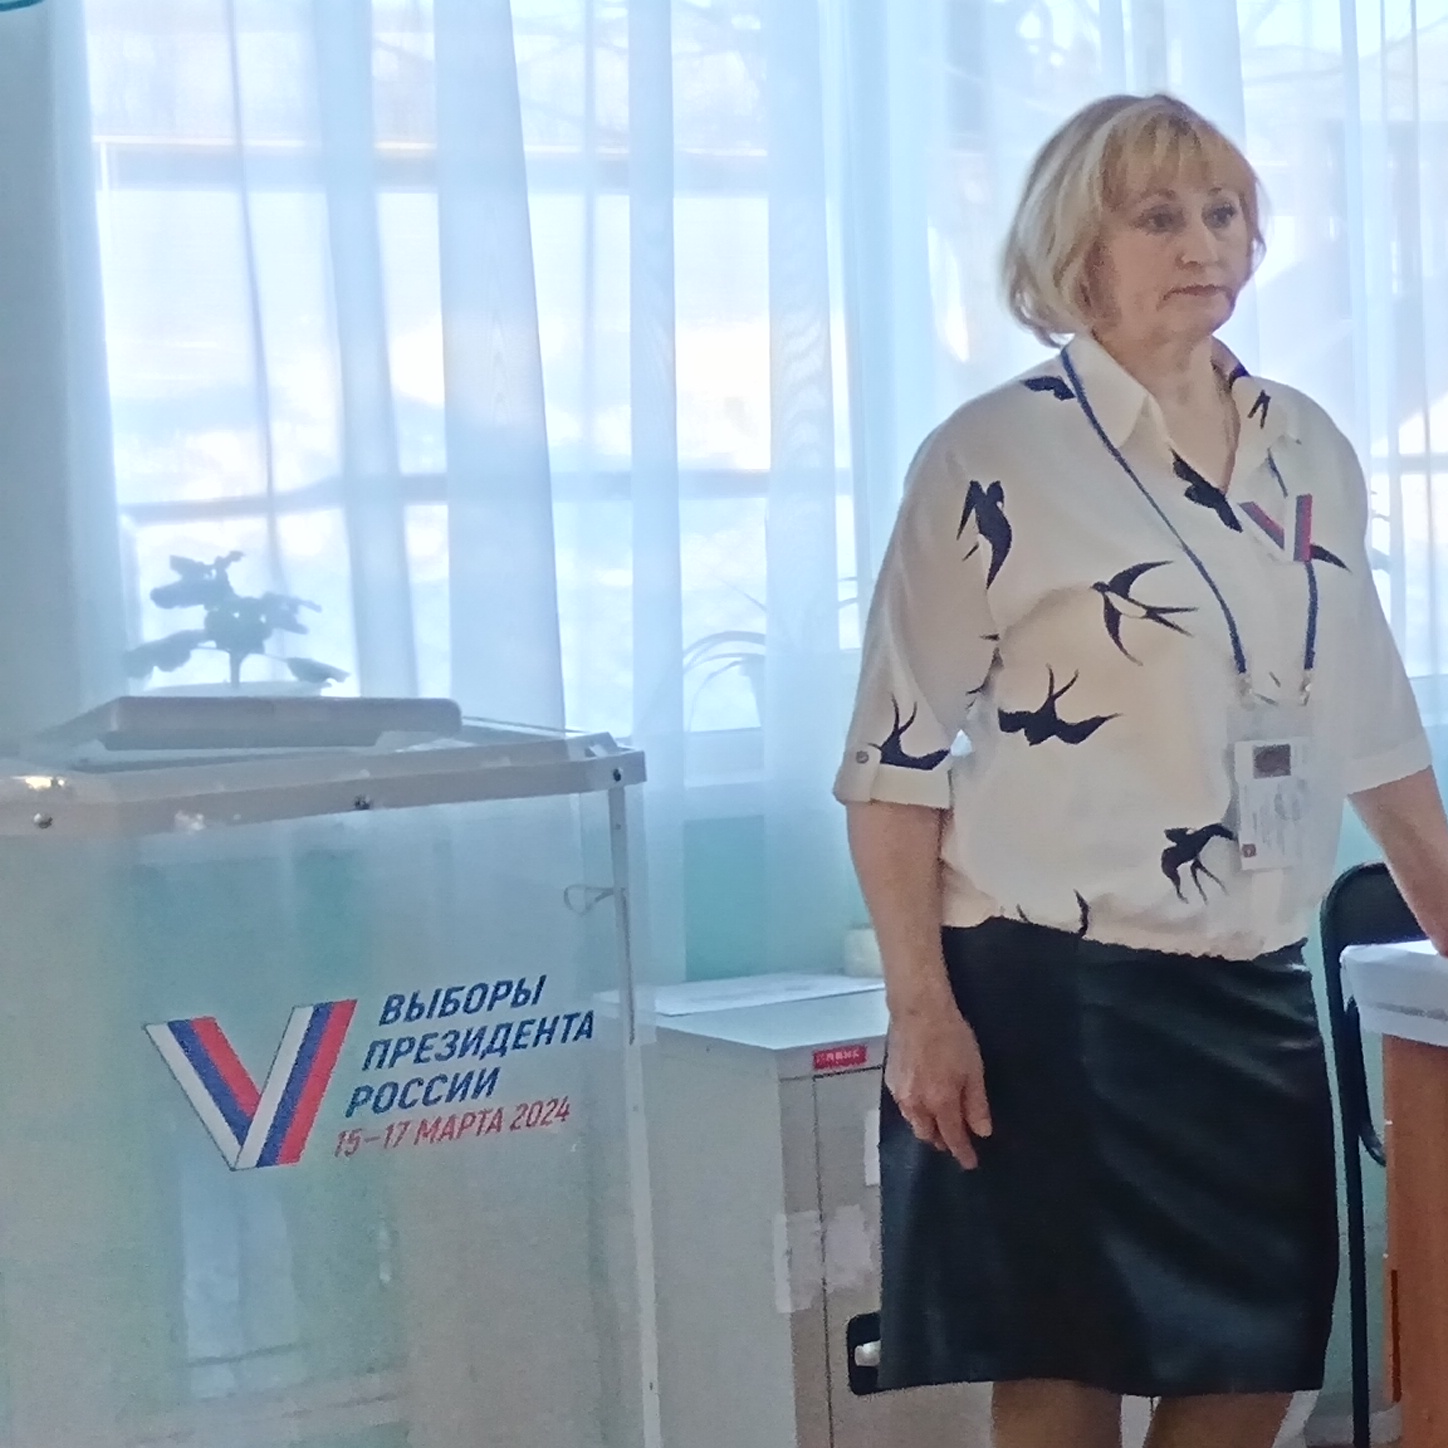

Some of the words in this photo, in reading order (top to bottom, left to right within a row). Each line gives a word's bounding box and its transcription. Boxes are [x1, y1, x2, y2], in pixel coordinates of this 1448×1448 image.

[378, 974, 547, 1027] ВЫБОРЫ
[361, 1010, 595, 1072] ПРЕЗИДЕНТА
[345, 1066, 501, 1119] РОССИИ
[413, 1106, 506, 1147] МАРТА
[509, 1095, 572, 1133] 2024
